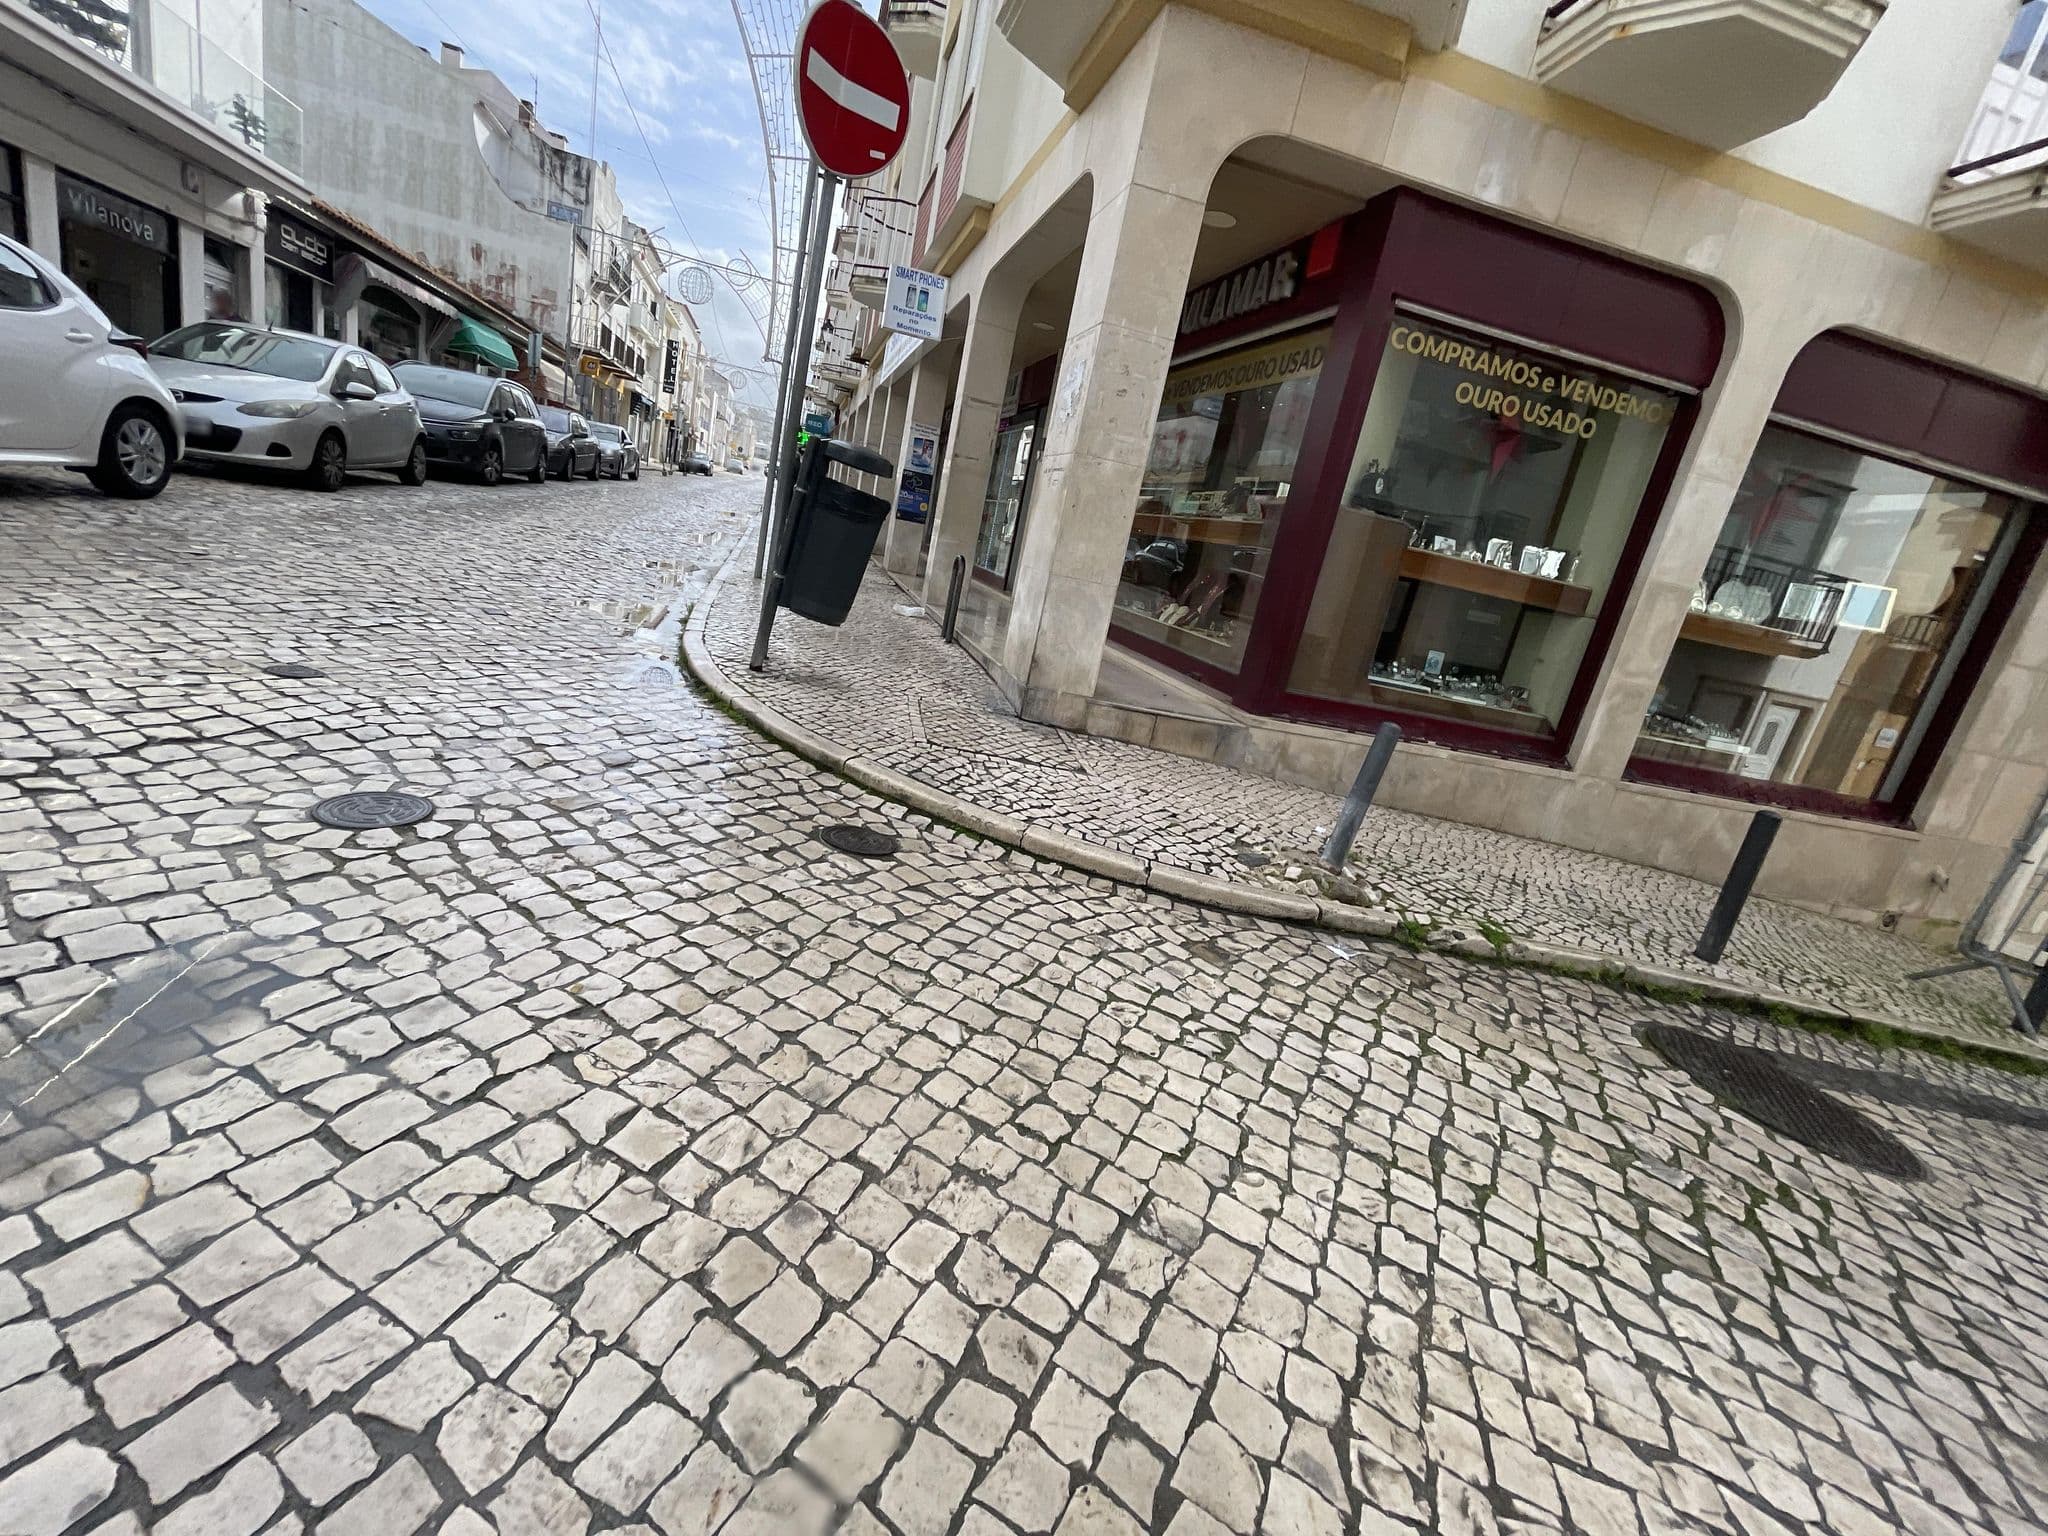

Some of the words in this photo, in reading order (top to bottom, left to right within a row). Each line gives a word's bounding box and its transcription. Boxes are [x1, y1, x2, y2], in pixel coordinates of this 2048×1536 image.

[68, 188, 154, 241] Vilanova
[896, 266, 919, 281] SMART
[919, 273, 945, 290] PHONES
[892, 304, 937, 322] Reparações
[896, 321, 932, 337] Momento
[670, 341, 679, 383] HOTEL
[1175, 368, 1233, 397] VENDEMOS
[1235, 357, 1276, 385] OURO
[1279, 346, 1324, 375] USAD
[1391, 327, 1542, 389] COMPRAMOS
[1541, 376, 1555, 393] e
[1455, 381, 1521, 418] OURO
[1522, 399, 1597, 440] USADO
